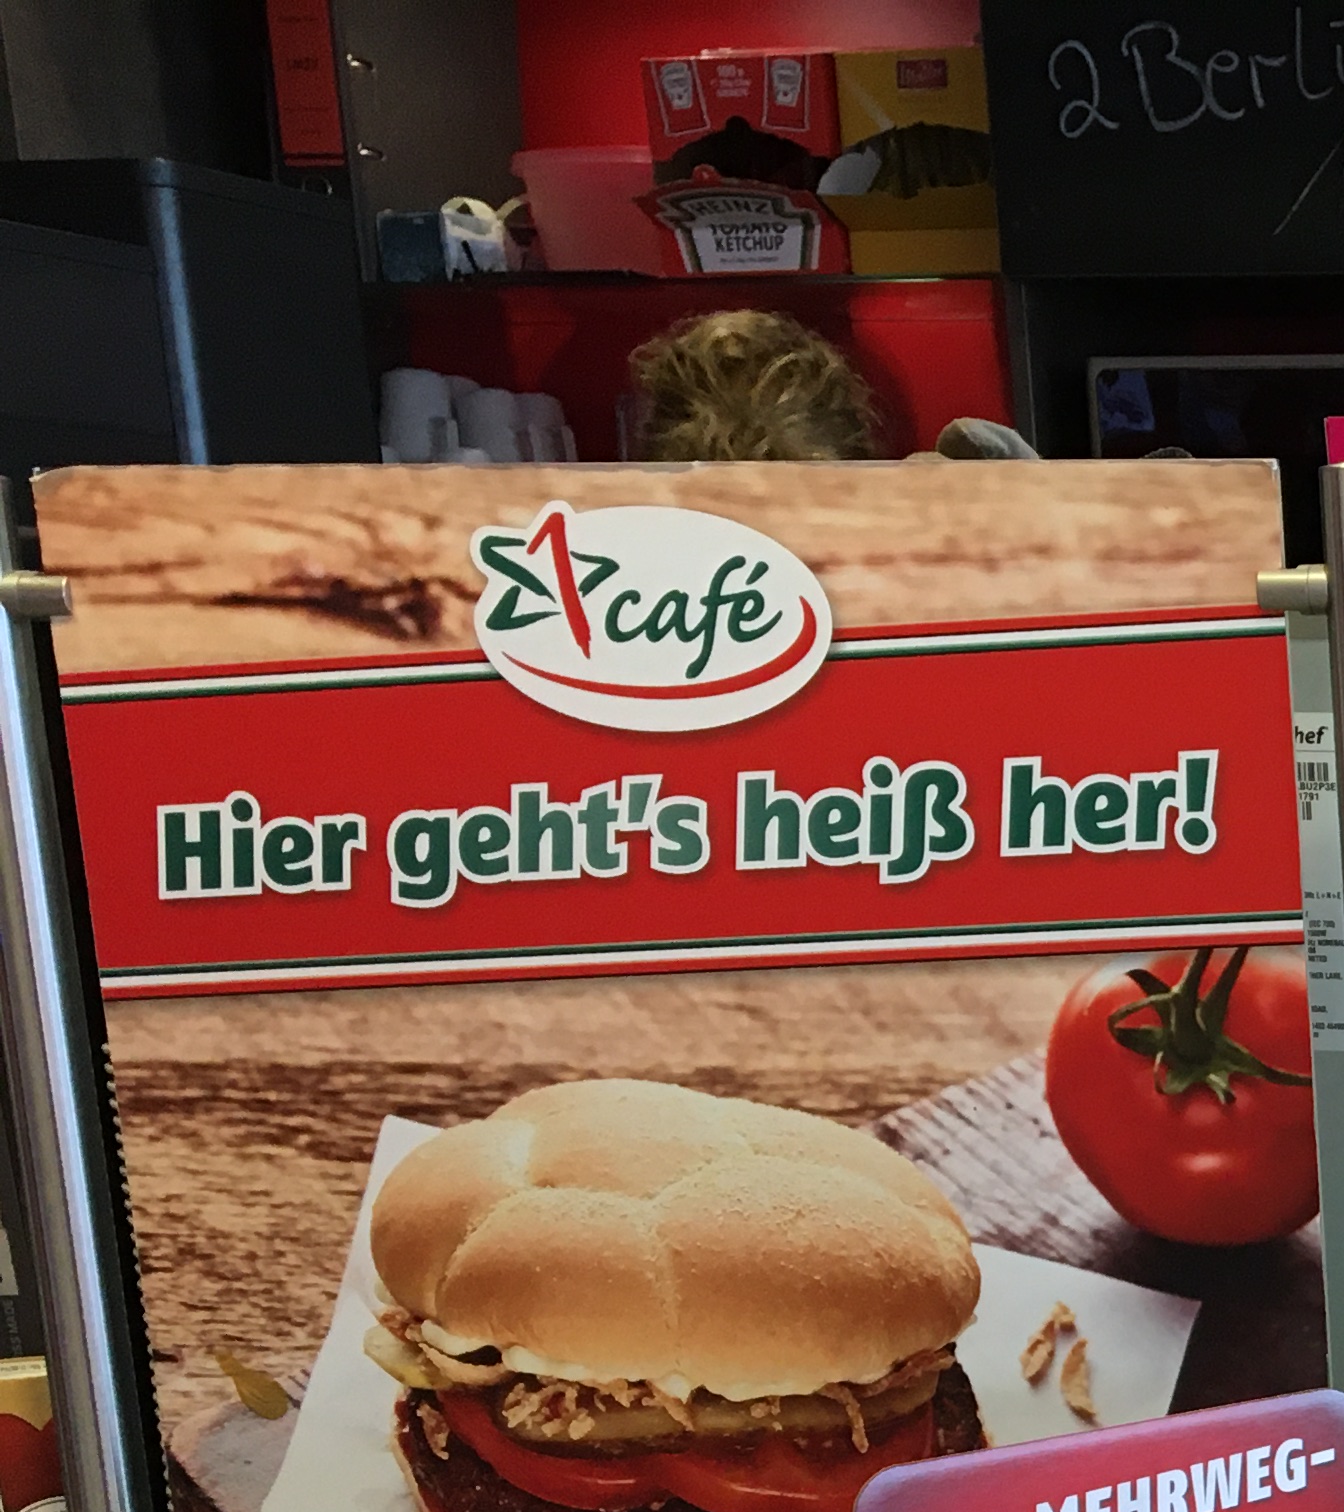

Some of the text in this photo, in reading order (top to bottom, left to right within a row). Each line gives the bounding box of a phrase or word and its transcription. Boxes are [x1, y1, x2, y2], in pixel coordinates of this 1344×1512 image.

[1048, 40, 1119, 138] 2
[715, 235, 785, 252] KETCHUP
[603, 555, 781, 677] café
[158, 749, 1220, 910] Hier geht's heiß her!
